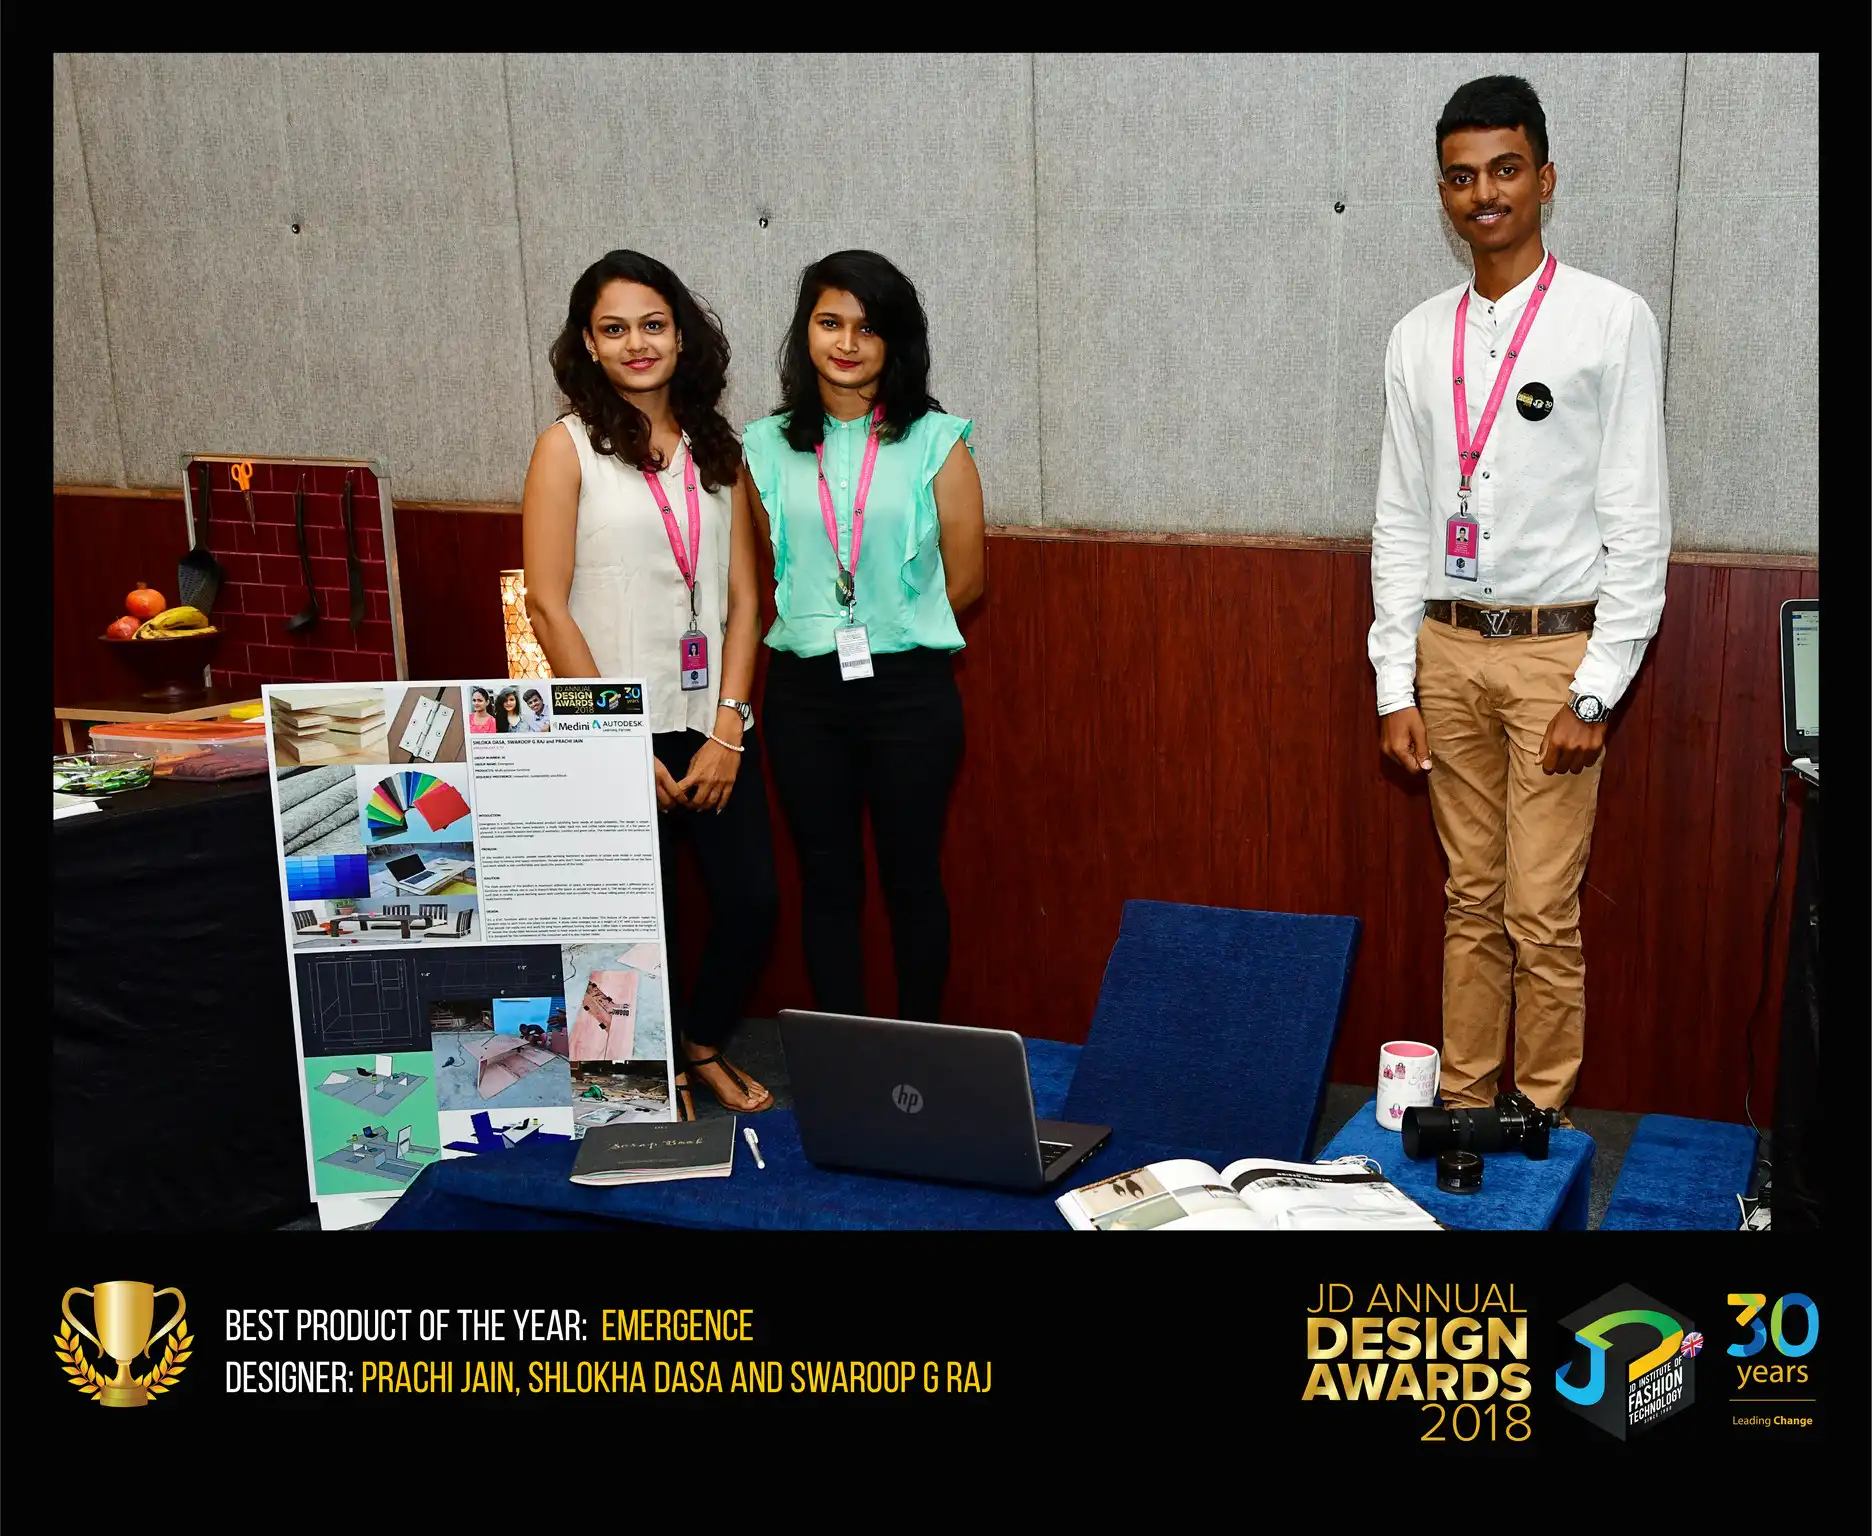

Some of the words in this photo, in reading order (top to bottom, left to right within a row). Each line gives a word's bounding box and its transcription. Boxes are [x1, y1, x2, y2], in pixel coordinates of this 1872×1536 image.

[554, 692, 593, 700] DESIGN
[624, 687, 640, 699] 30
[558, 721, 590, 731] Medini
[898, 1084, 918, 1113] hp
